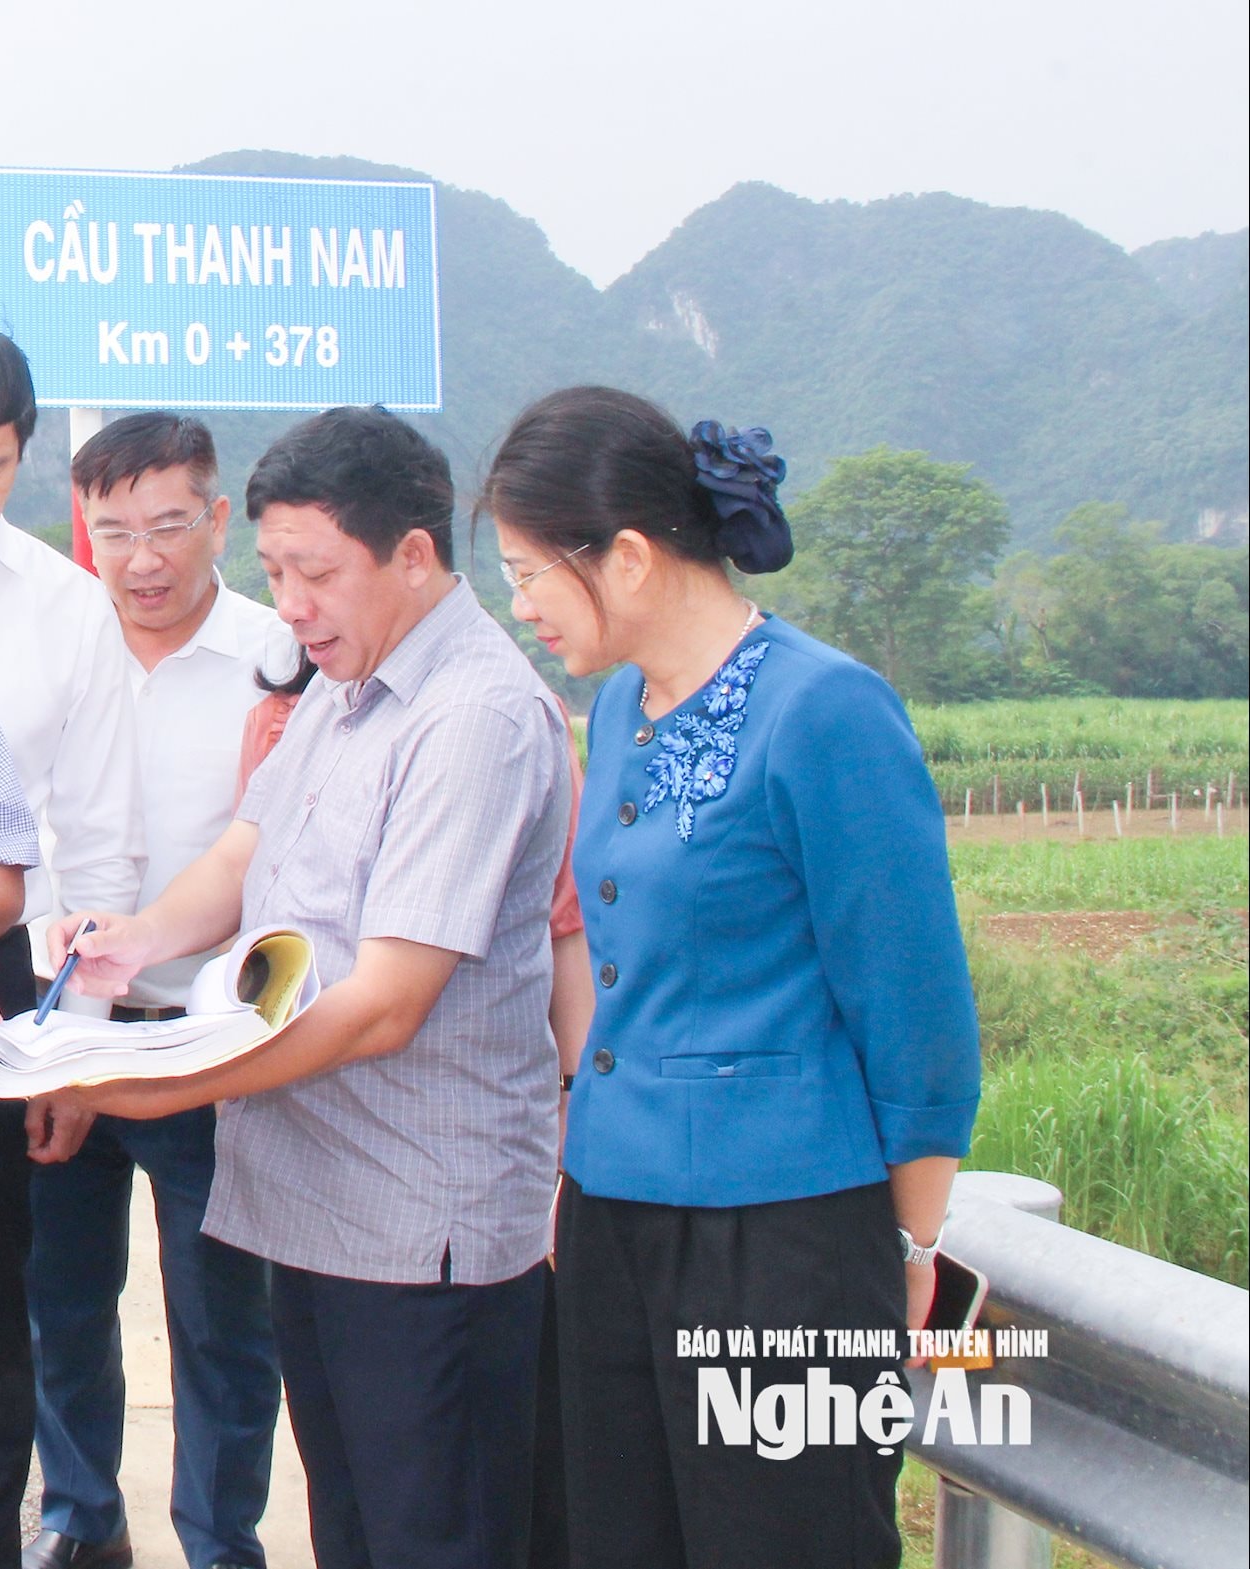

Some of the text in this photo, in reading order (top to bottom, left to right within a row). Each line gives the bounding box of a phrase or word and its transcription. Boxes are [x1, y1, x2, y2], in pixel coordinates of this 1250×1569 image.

[23, 199, 405, 289] CẦU THANH NAM
[98, 320, 339, 368] Km 0 + 378
